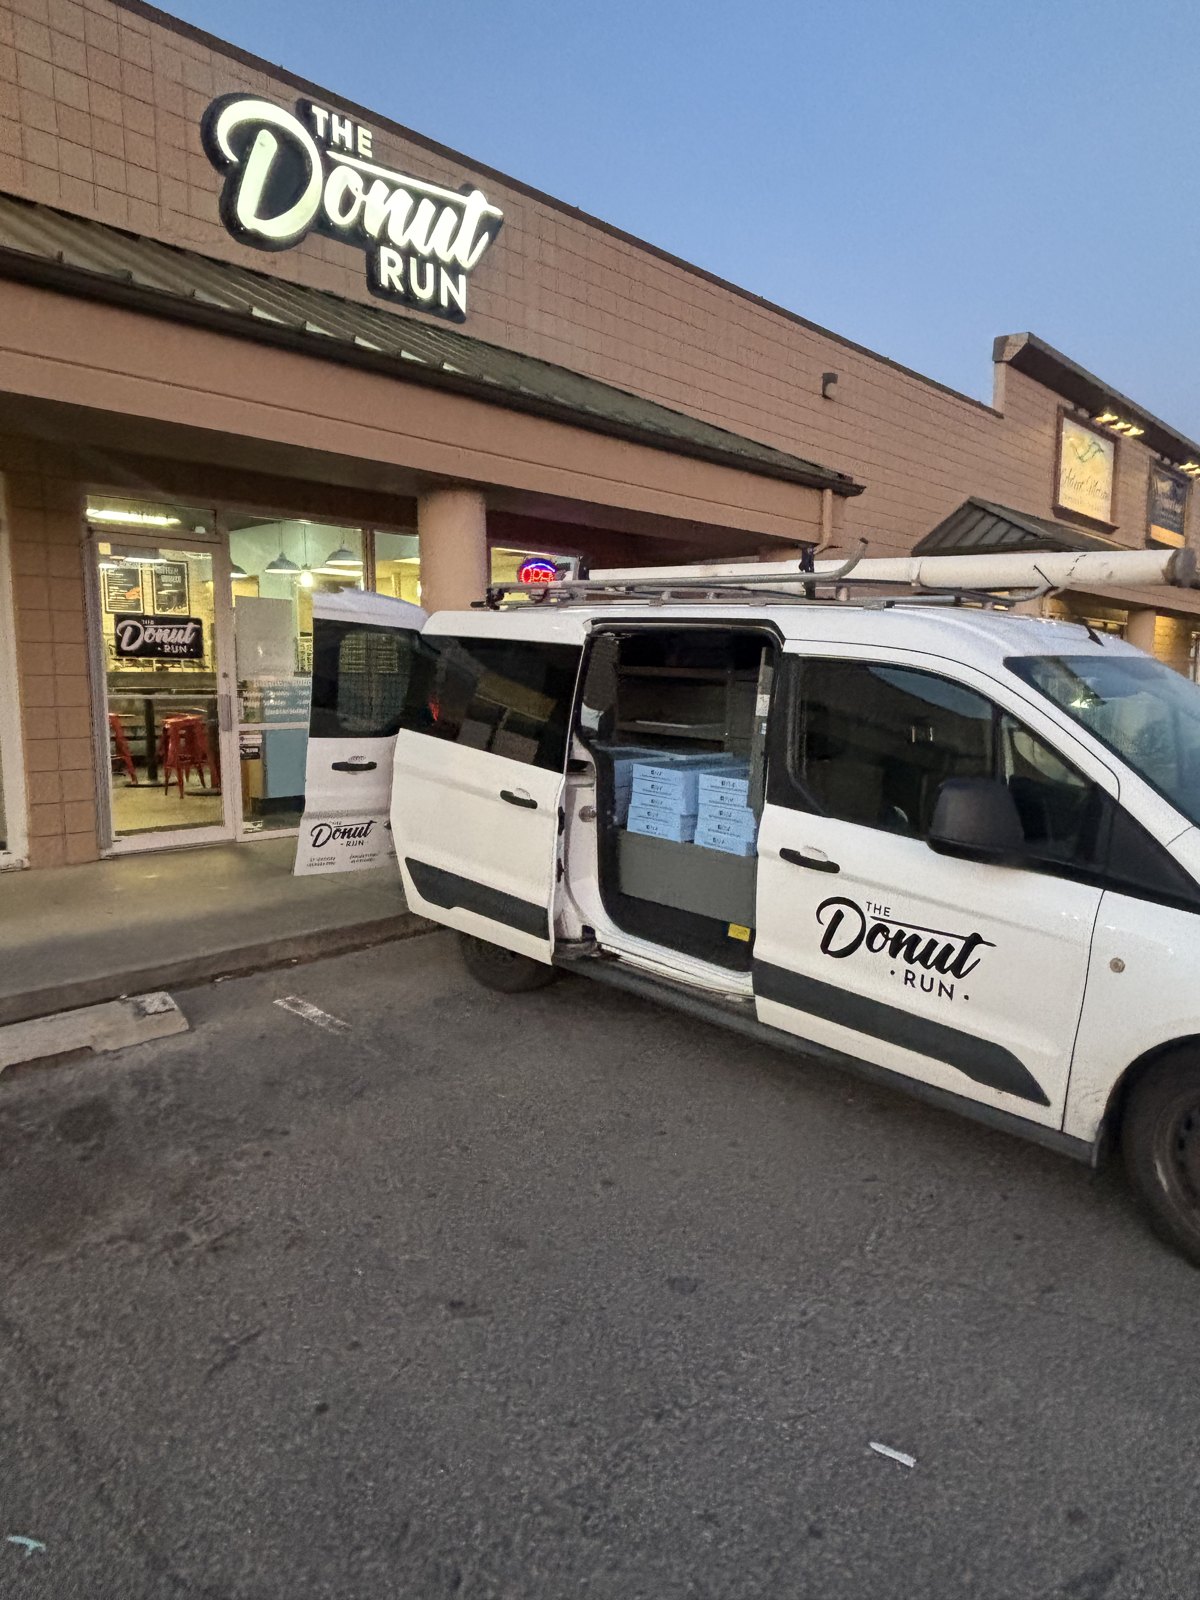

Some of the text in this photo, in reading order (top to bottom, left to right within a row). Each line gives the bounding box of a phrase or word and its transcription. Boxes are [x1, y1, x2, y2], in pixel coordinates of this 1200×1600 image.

[311, 104, 373, 158] THE
[217, 99, 504, 269] Donut
[379, 245, 467, 315] RUN
[116, 619, 201, 651] Donut
[164, 644, 187, 653] RUN
[310, 820, 377, 848] Donut
[866, 901, 891, 917] THE
[816, 896, 997, 979] Donut
[904, 969, 955, 1001] RUN
